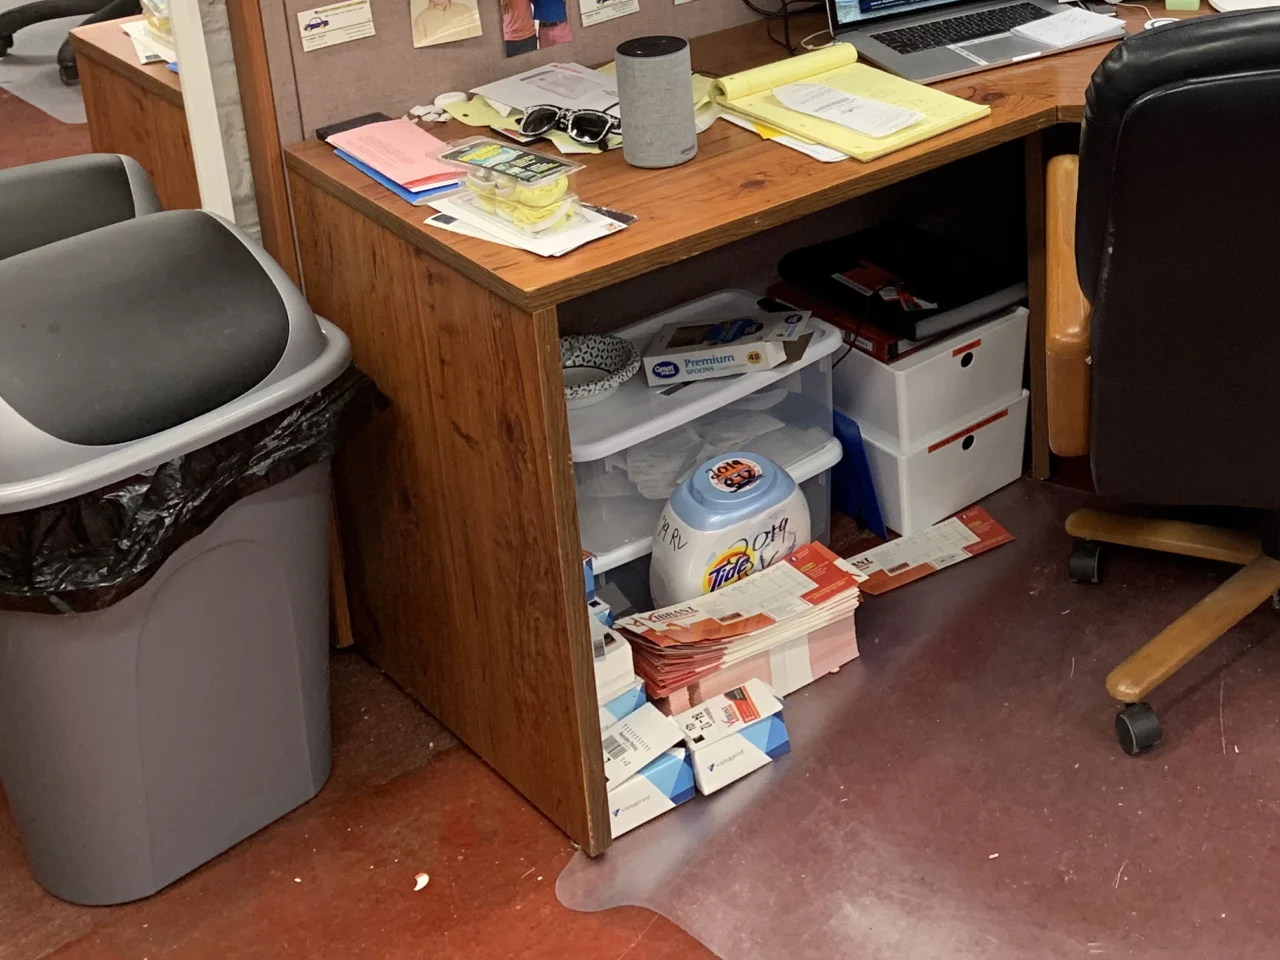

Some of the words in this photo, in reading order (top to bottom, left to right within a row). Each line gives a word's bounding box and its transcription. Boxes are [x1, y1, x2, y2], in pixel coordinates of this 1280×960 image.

[684, 354, 735, 368] Premium
[748, 353, 760, 361] 48
[686, 367, 714, 375] SPOONS
[708, 555, 751, 592] Tide
